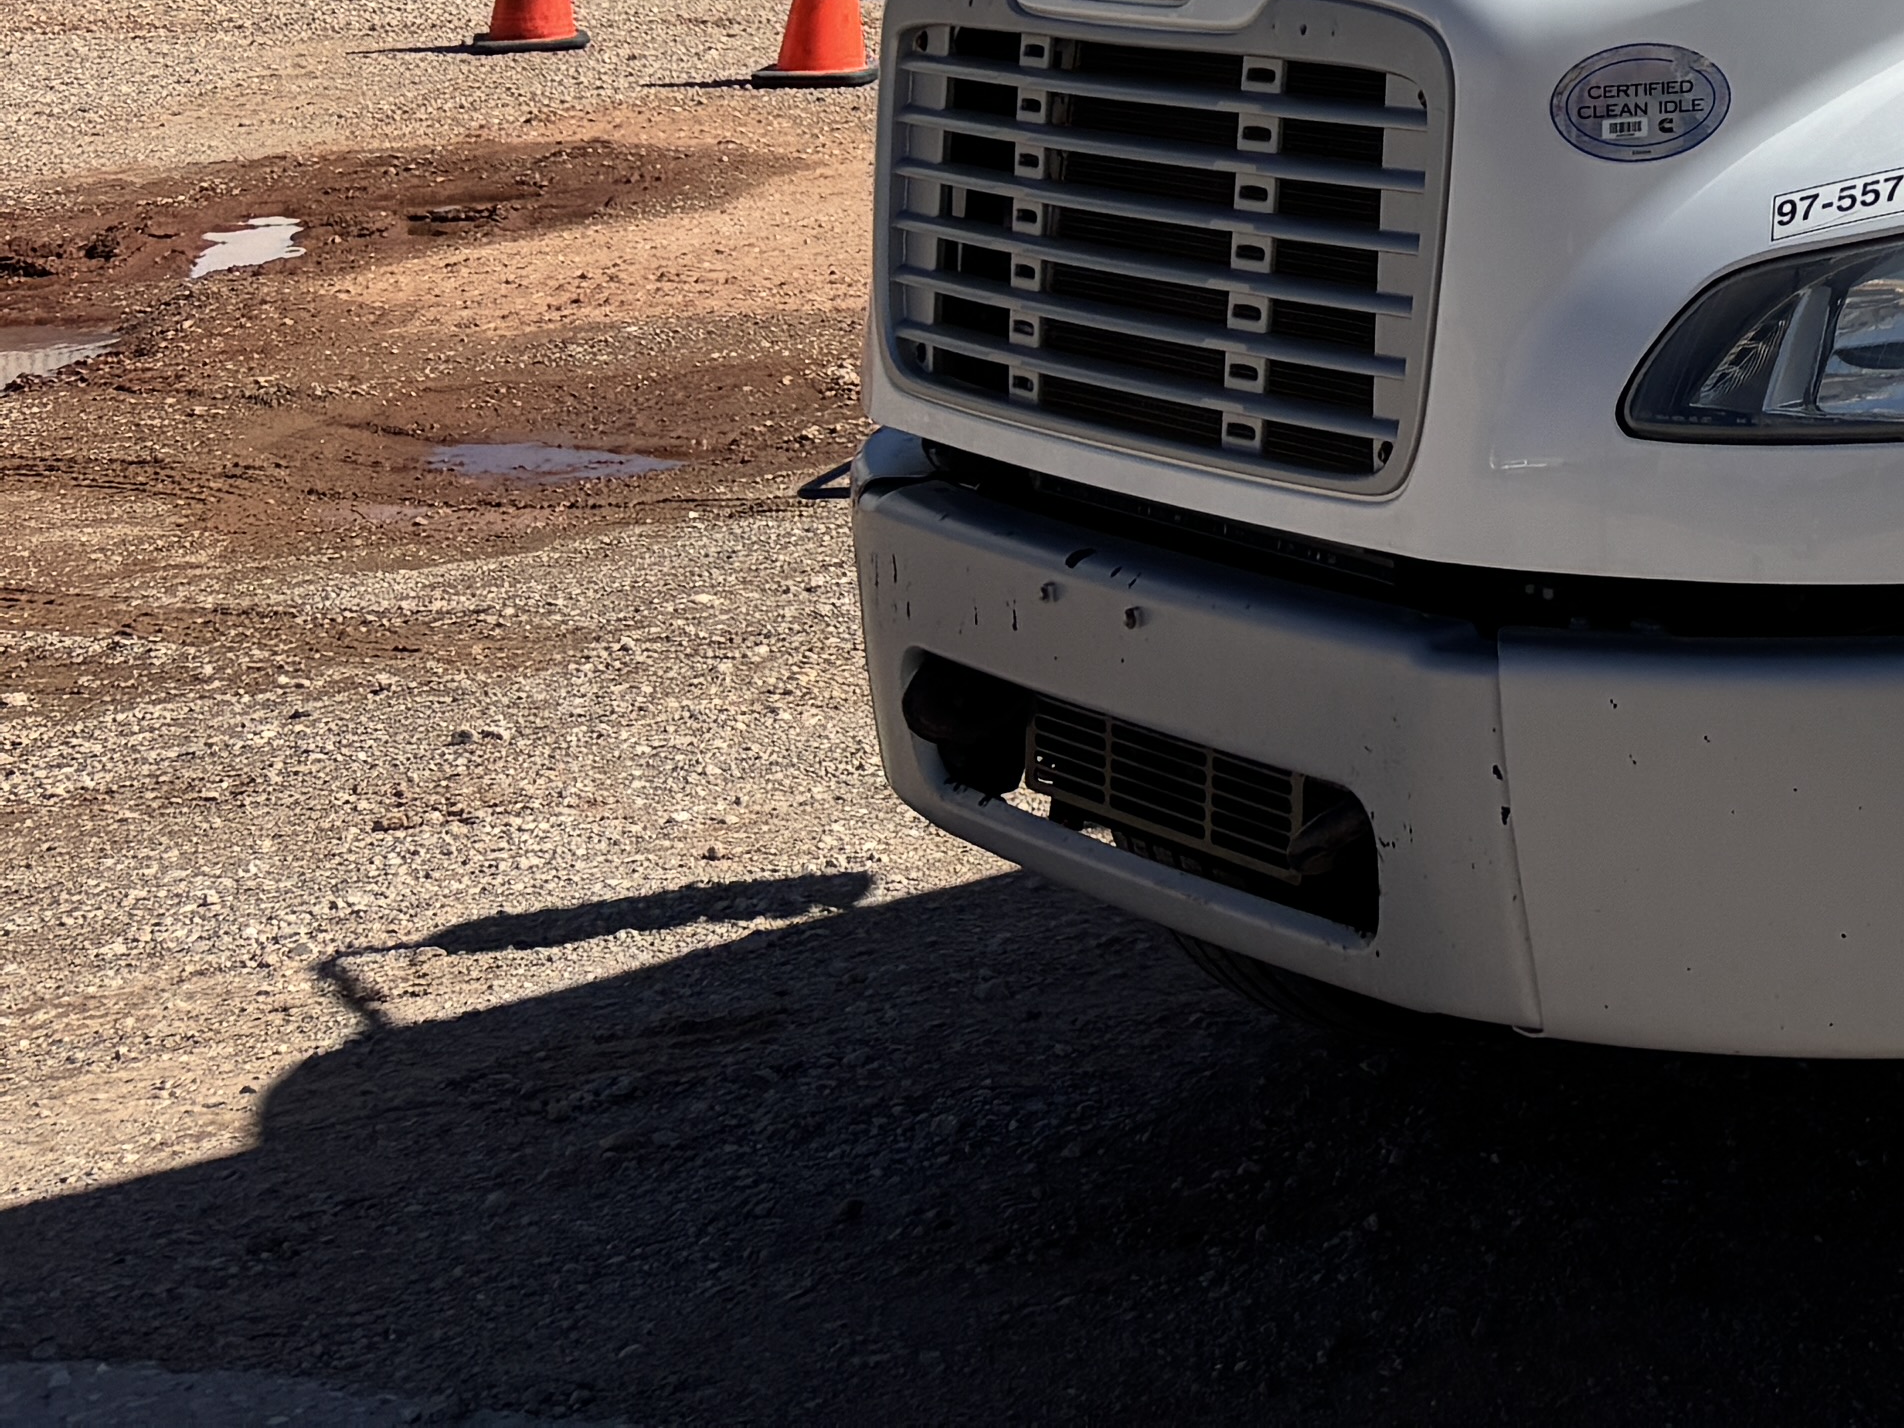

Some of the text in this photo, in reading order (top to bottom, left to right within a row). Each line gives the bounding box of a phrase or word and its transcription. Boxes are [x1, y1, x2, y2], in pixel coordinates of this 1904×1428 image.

[1587, 80, 1694, 100] CERTIFIED
[1577, 98, 1705, 120] CLEAN IDLE
